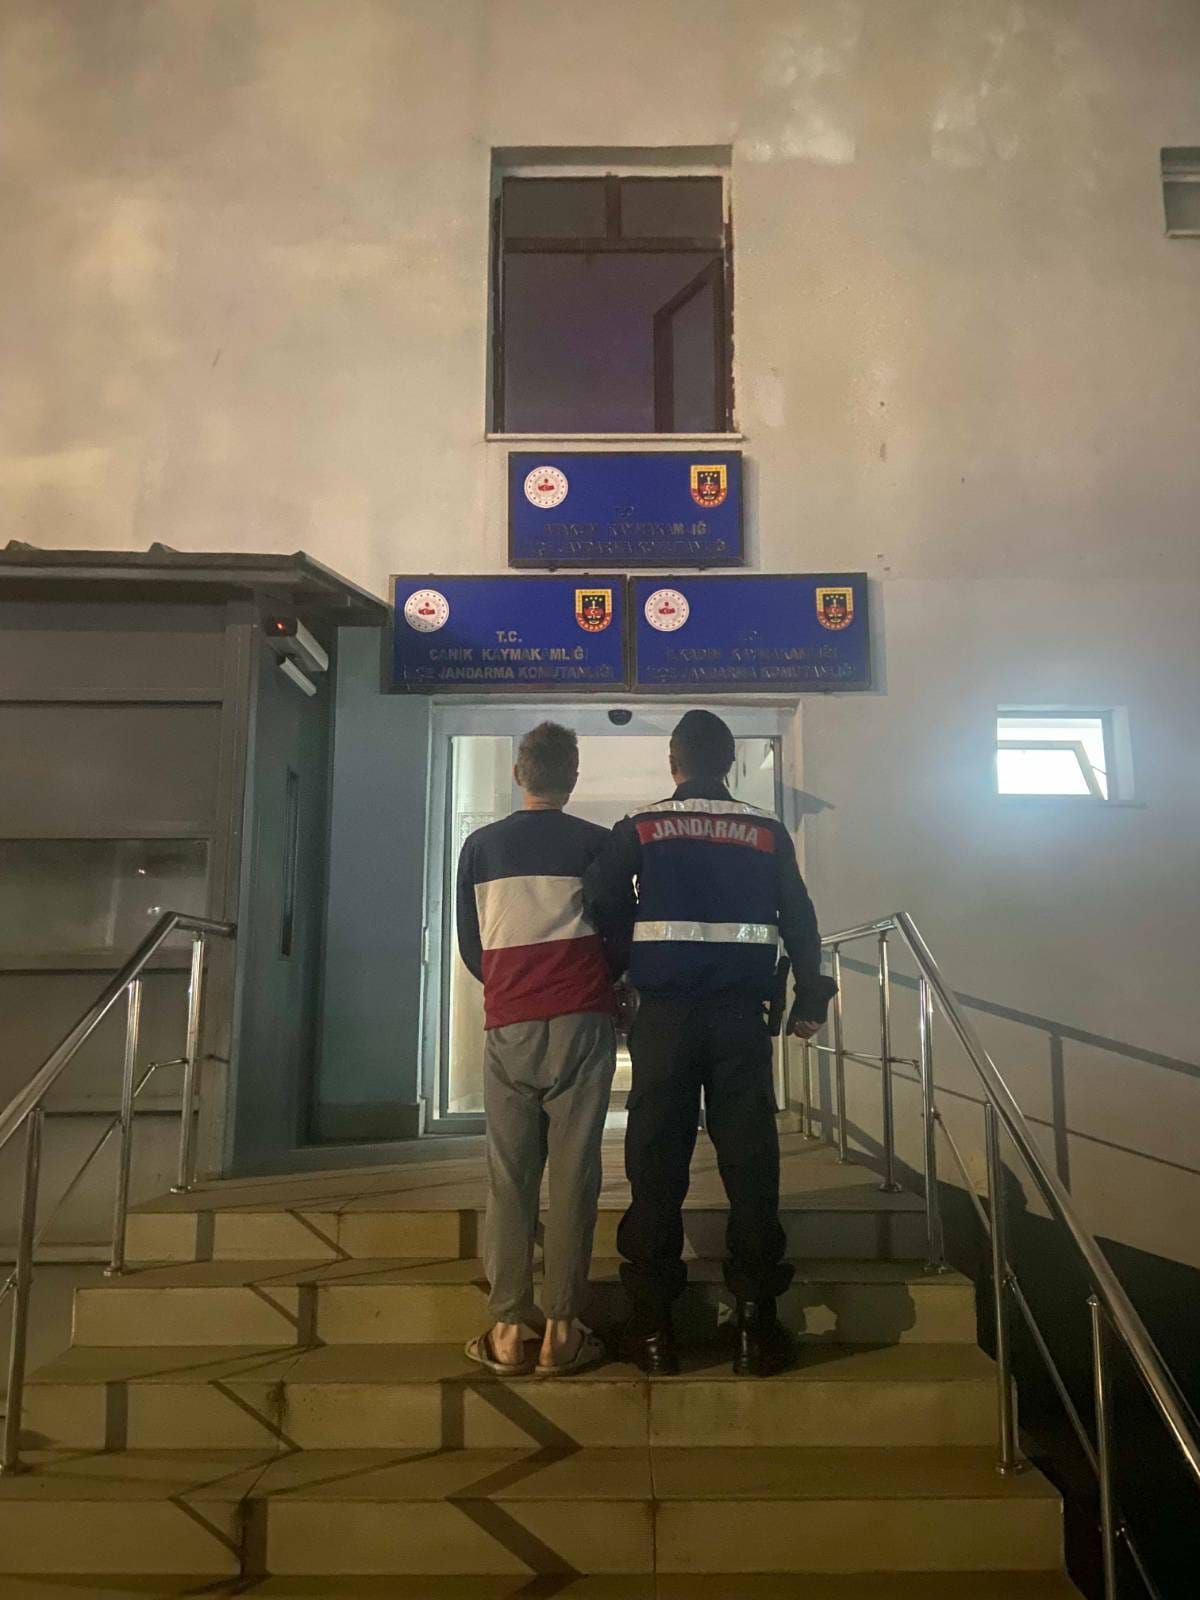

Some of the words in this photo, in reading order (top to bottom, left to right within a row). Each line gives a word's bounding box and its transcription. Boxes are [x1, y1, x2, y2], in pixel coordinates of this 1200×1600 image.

[496, 630, 523, 643] T.C.
[482, 644, 588, 661] KAYMAKMLĞI
[652, 818, 758, 846] JANDARMA
